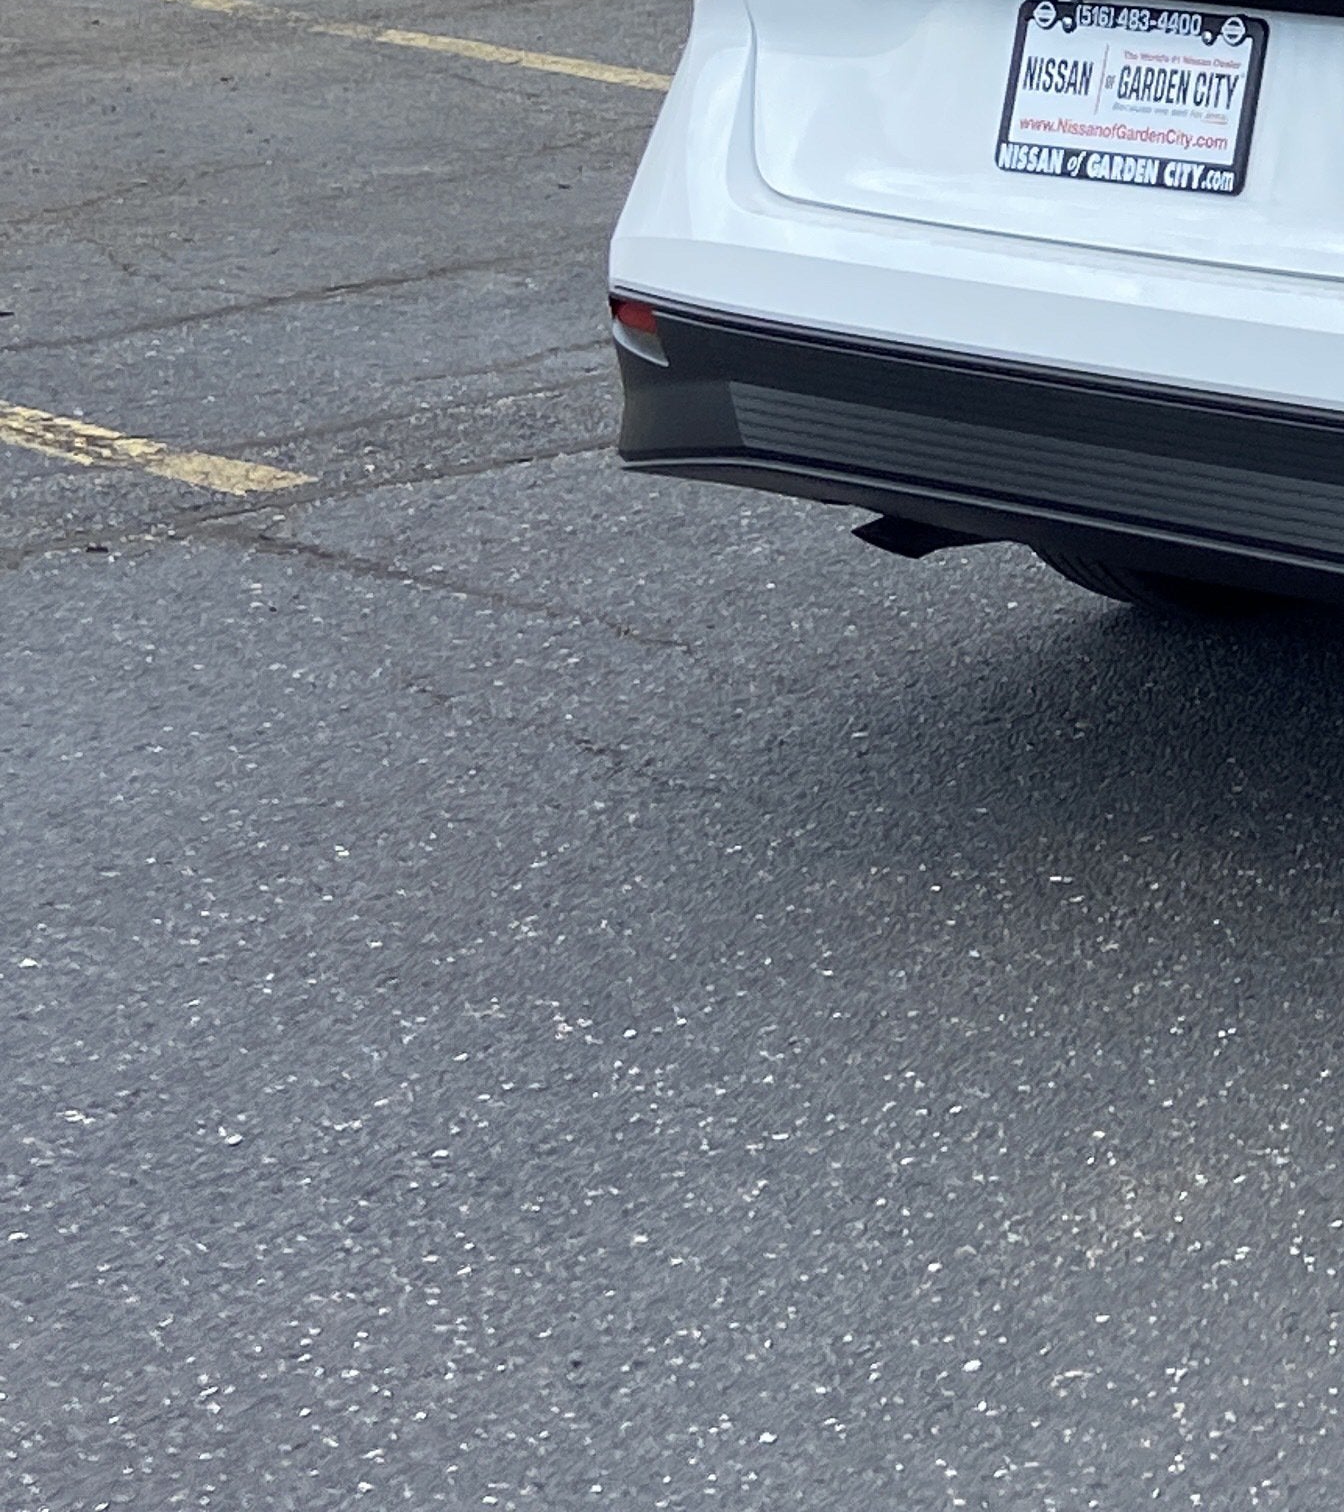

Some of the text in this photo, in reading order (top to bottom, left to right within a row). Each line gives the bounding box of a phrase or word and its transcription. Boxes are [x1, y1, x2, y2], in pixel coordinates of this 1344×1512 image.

[1077, 5, 1203, 36] (516) 483-4400
[1022, 55, 1094, 97] NISSAN
[1116, 65, 1192, 106] GARDEN
[1193, 72, 1240, 110] CITY
[1019, 117, 1228, 150] www.NissanofGardenCity.com
[998, 143, 1065, 175] NISSAN
[1086, 153, 1160, 186] GARDEN
